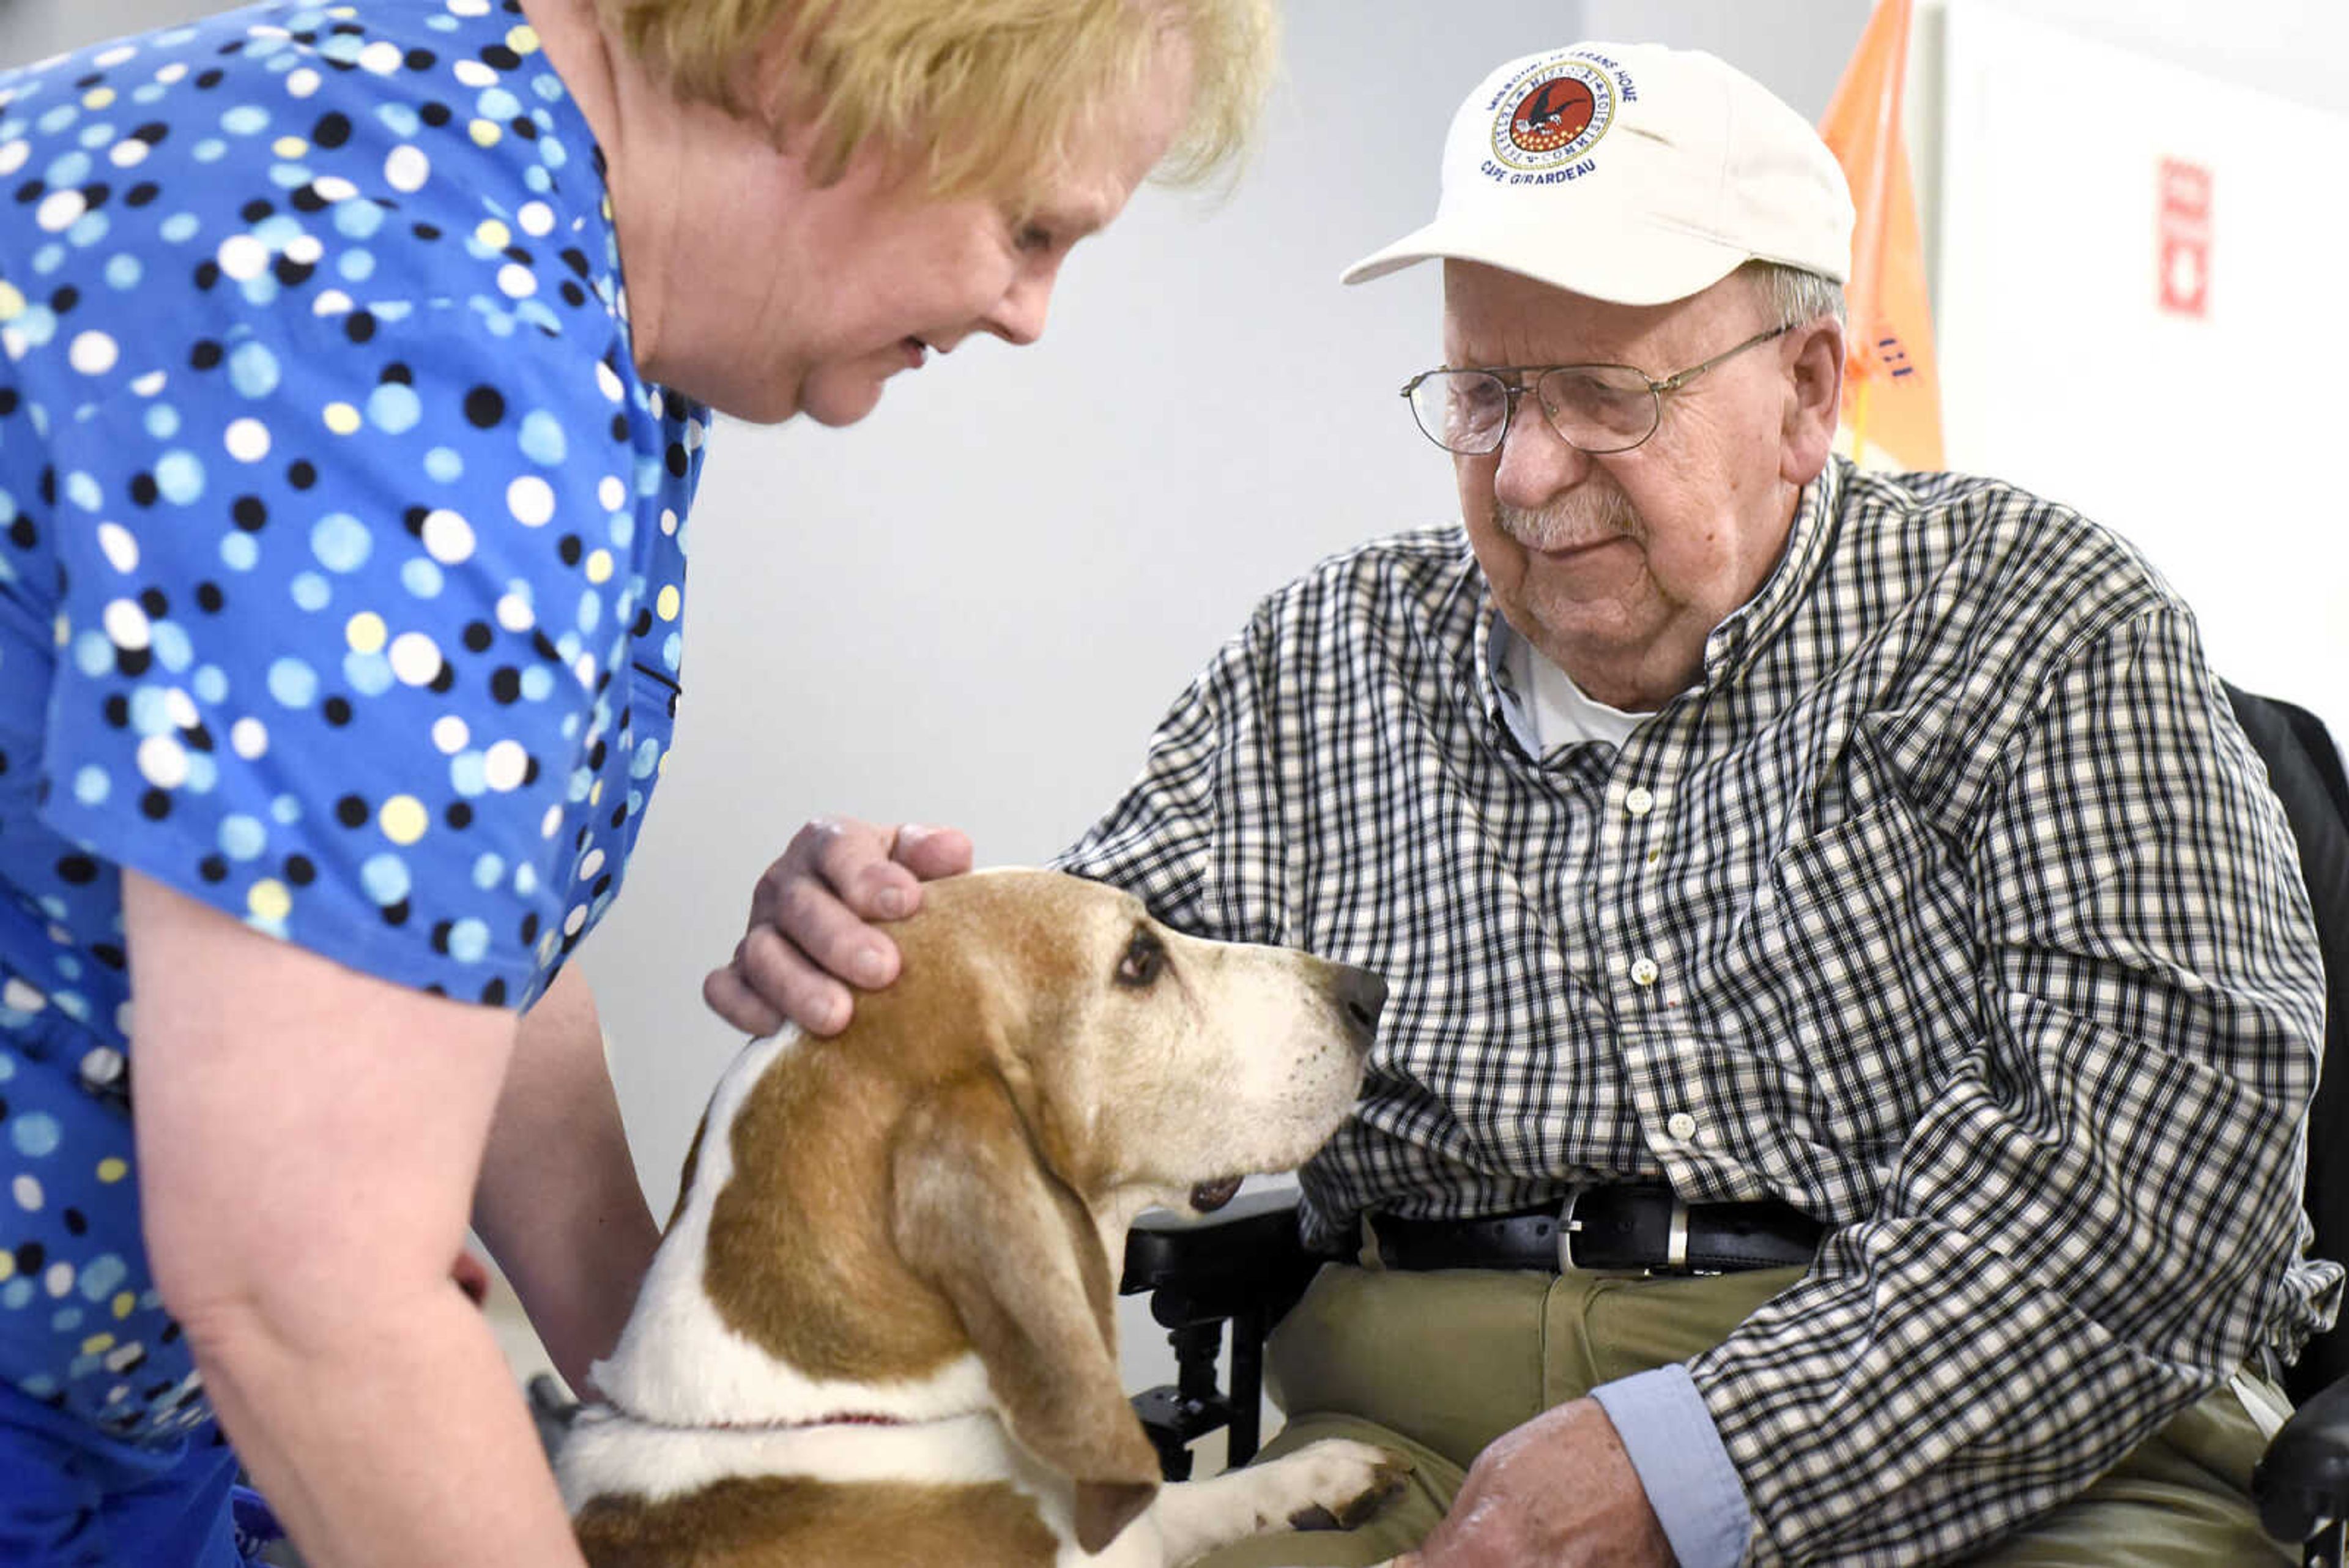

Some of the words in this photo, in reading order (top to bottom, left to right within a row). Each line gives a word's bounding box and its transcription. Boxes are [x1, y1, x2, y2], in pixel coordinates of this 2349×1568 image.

[1549, 51, 1619, 69] ERANS
[1613, 70, 1638, 103] HOME
[1480, 160, 1508, 182] CAPE
[1510, 158, 1595, 185] GIRARDEAU
